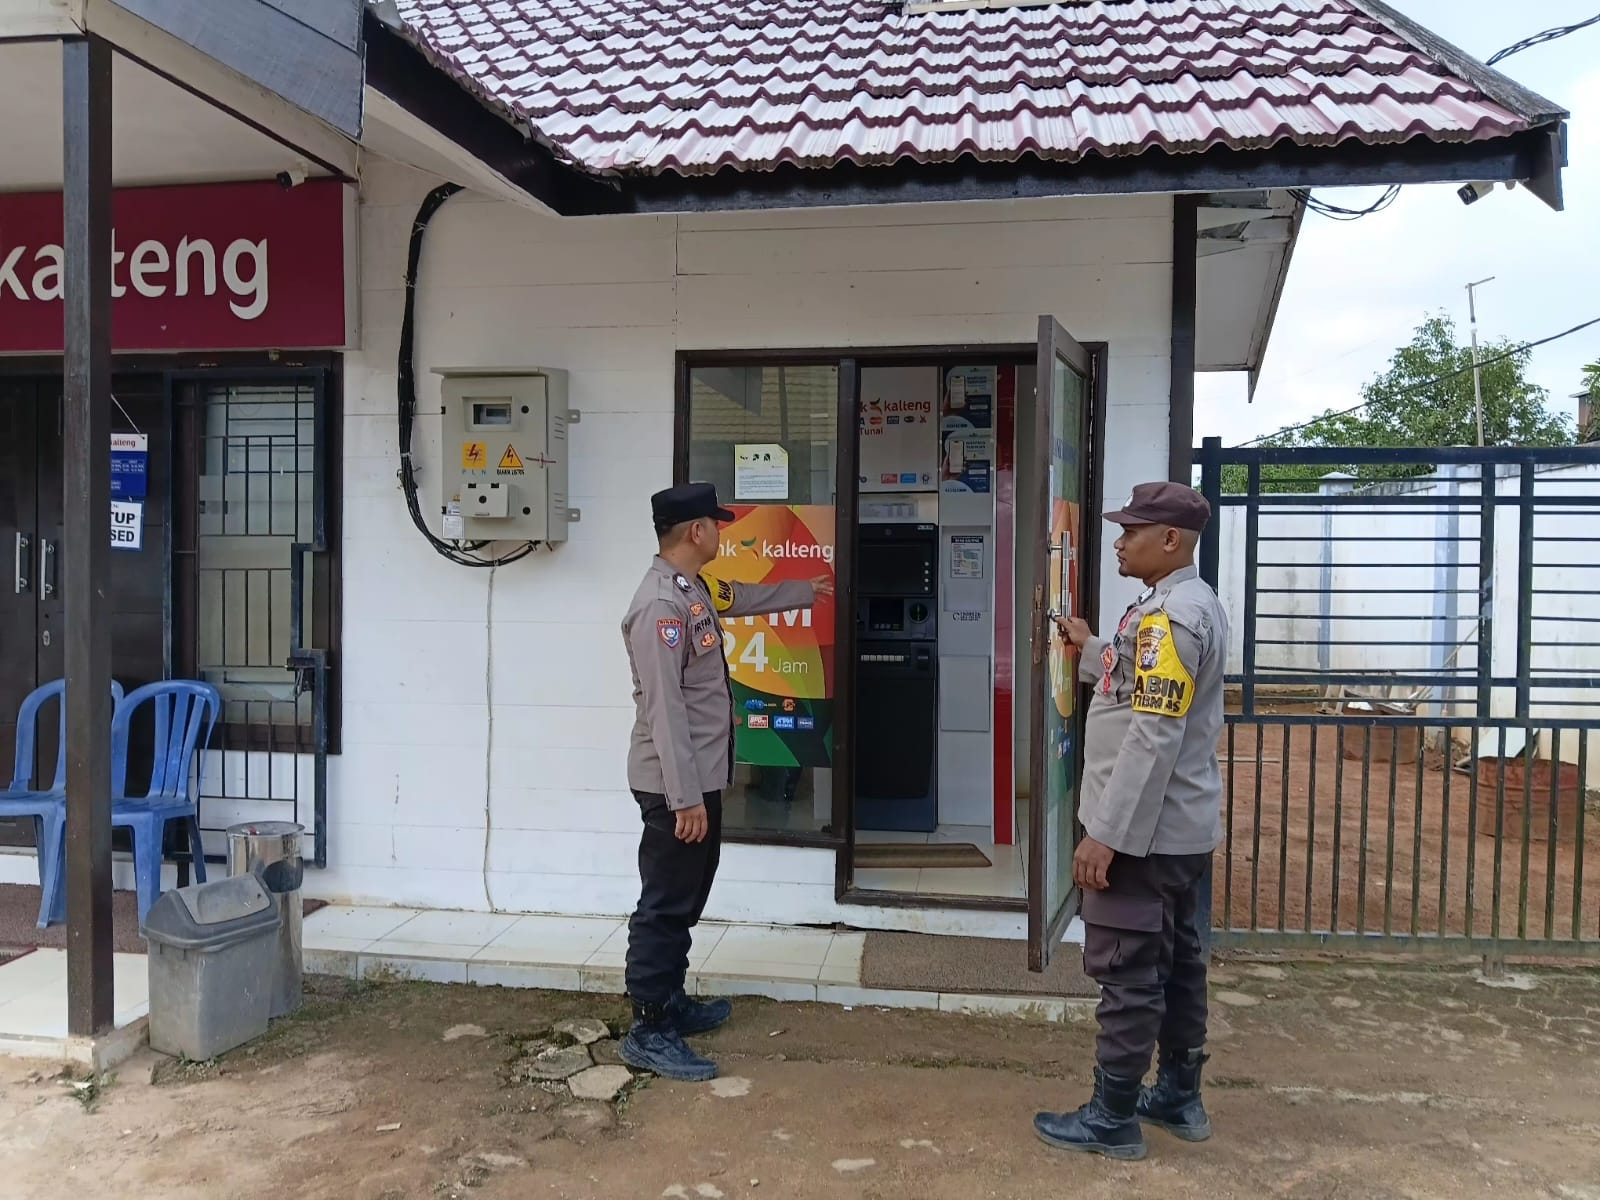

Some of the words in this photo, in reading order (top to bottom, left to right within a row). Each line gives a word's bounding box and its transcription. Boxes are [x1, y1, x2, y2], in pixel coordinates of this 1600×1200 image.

[884, 400, 931, 413] kalteng
[762, 539, 834, 563] kalteng
[771, 658, 808, 673] Jam
